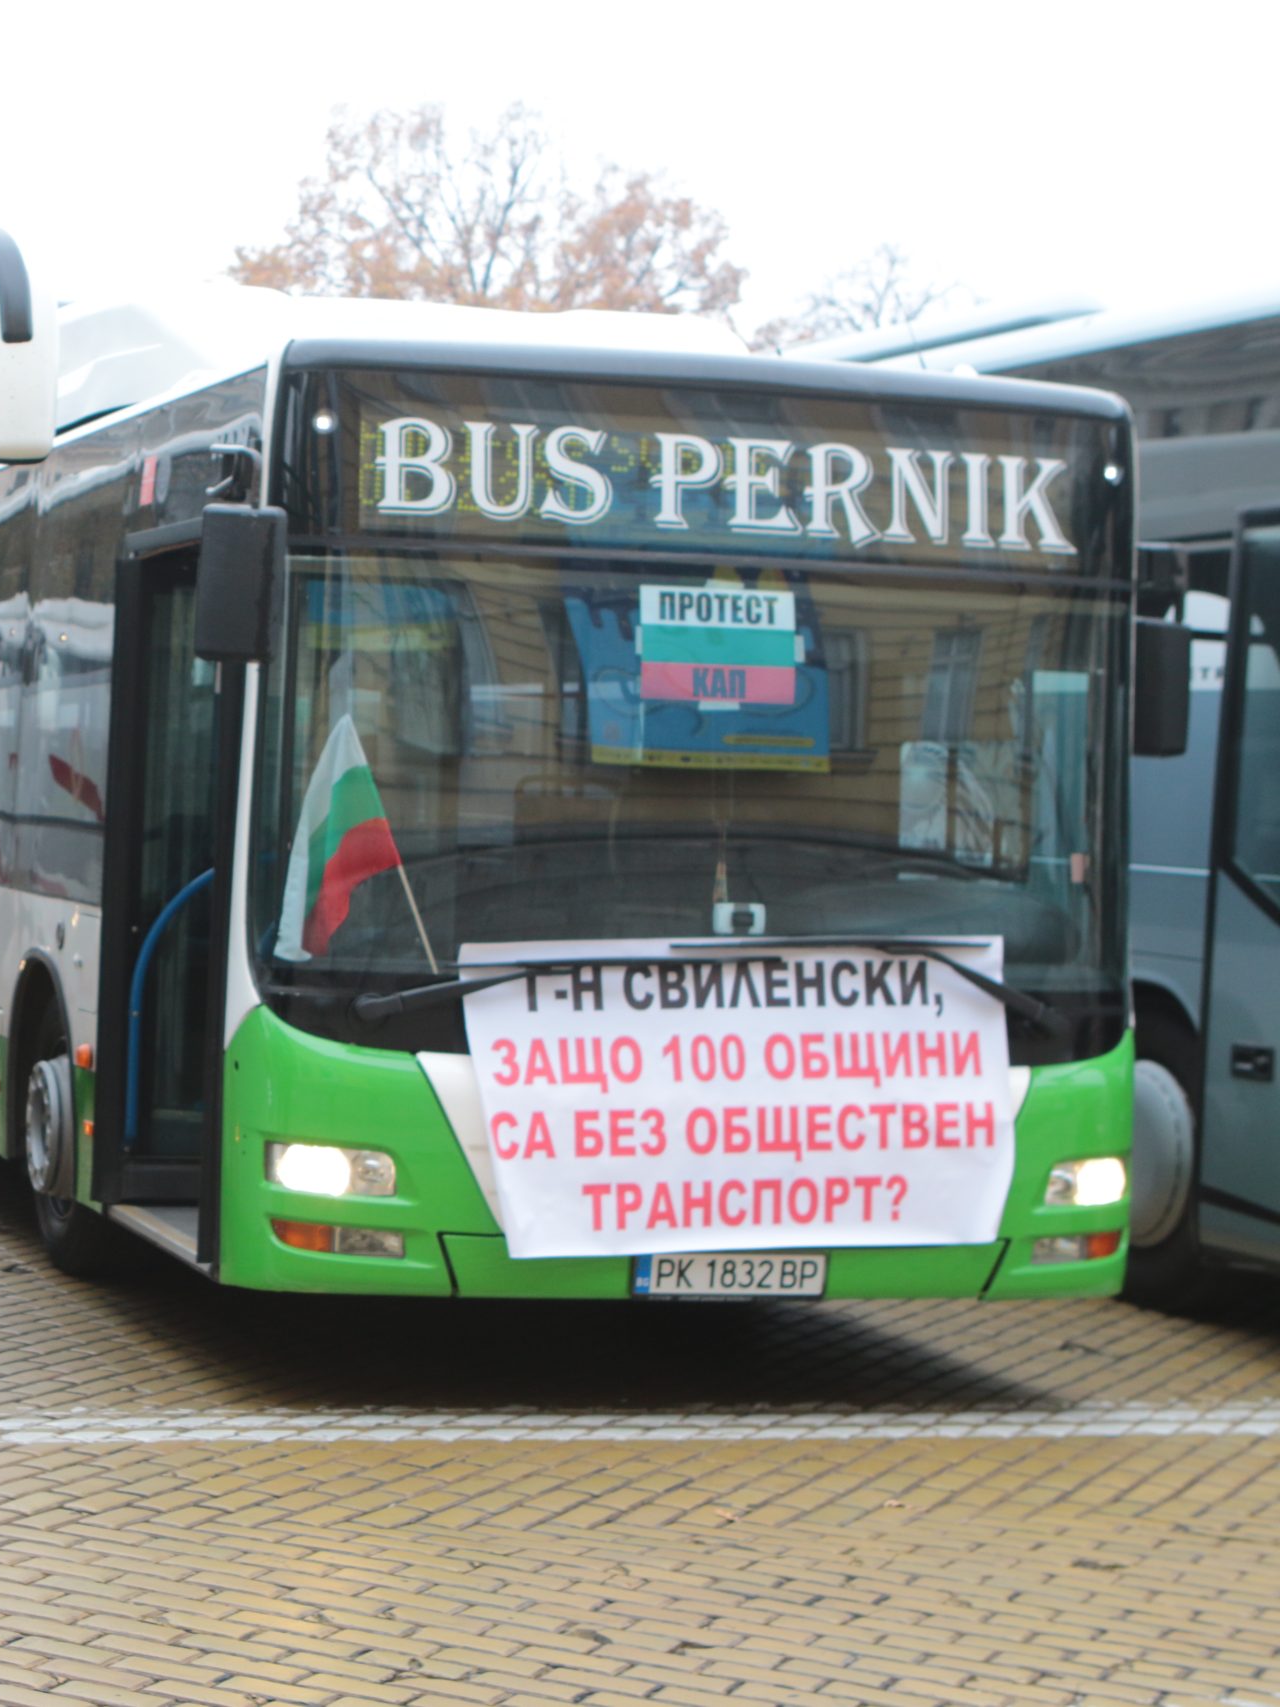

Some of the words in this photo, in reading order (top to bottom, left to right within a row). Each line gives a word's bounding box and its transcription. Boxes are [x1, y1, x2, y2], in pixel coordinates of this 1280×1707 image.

[374, 416, 614, 526] BUS
[648, 432, 1078, 555] PERNIK
[658, 590, 779, 625] ПРОТЕСТ
[692, 667, 747, 699] КАП
[623, 957, 944, 1018] СВИЛЕНСКИ,
[491, 1035, 644, 1094] ЗАЩО
[662, 1032, 746, 1083] 100
[764, 1030, 983, 1088] ОБЩИНИ
[490, 1110, 556, 1160] СА
[574, 1107, 668, 1158] БЕЗ
[685, 1101, 996, 1163] ОБЩЕСТВЕН
[581, 1173, 909, 1232] ТРАНСПОРТ?
[706, 1259, 775, 1289] 1832
